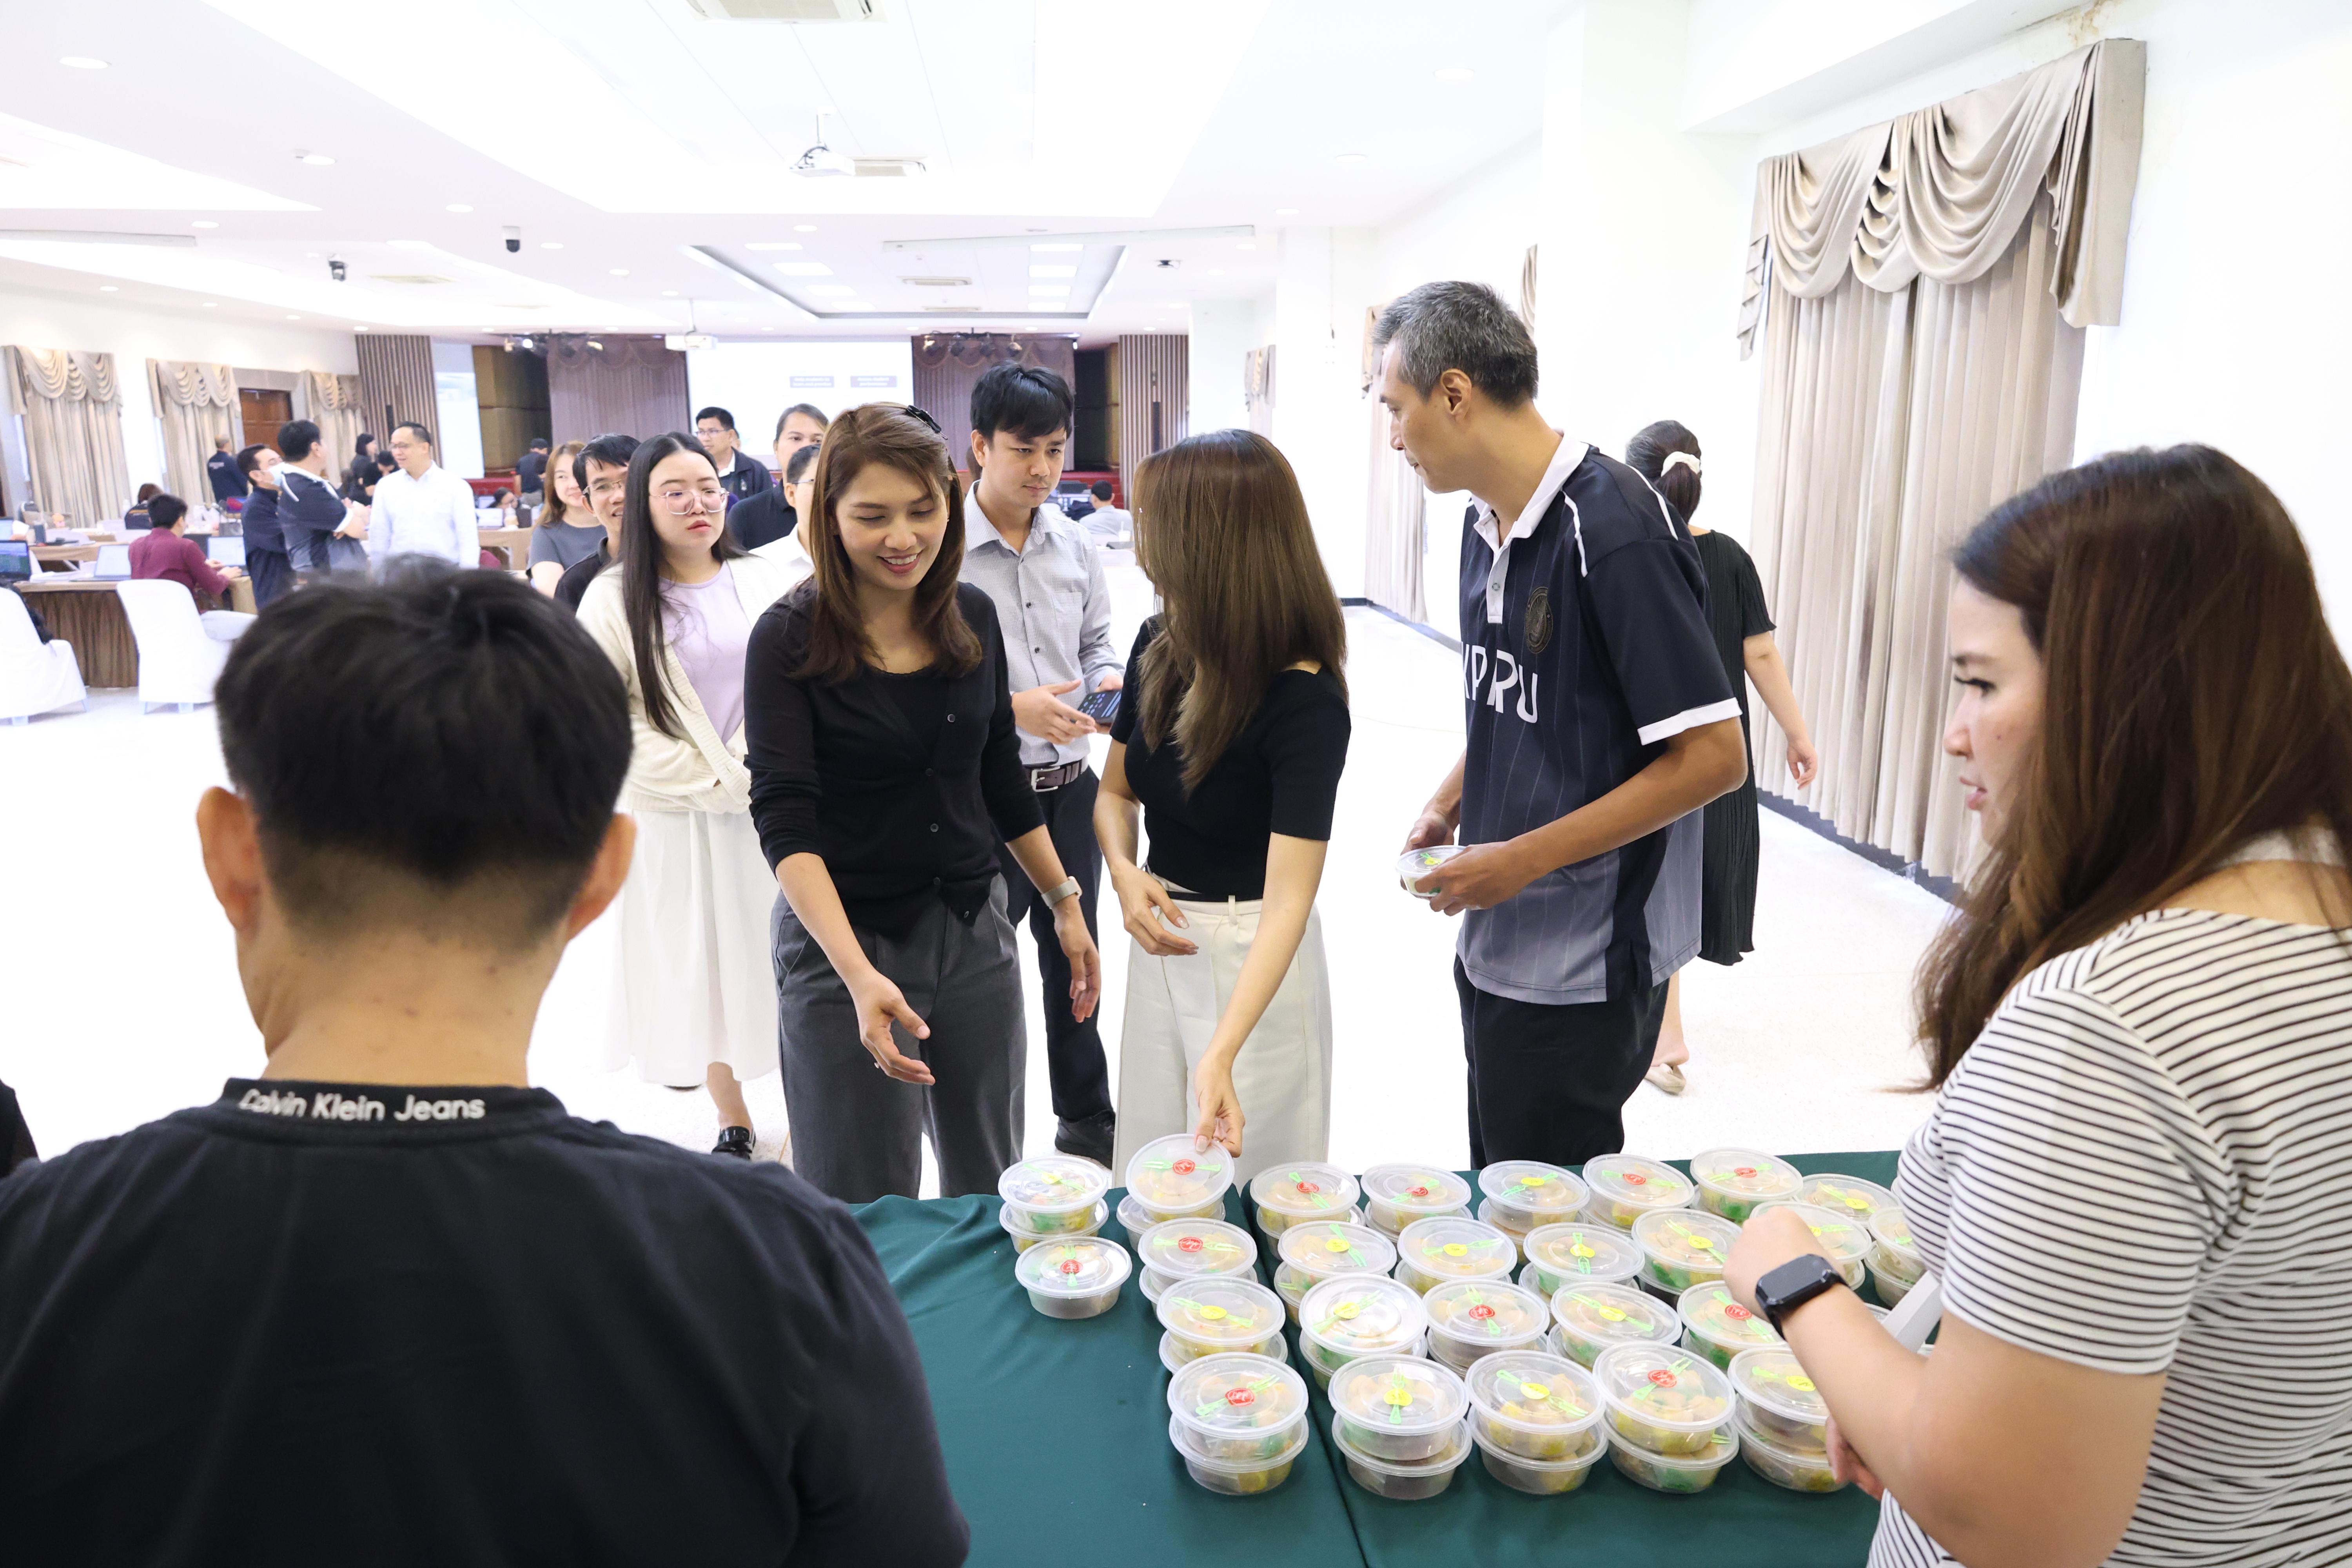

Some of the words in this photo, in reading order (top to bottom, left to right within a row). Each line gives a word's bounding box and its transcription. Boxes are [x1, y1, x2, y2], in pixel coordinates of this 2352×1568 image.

[238, 1089, 307, 1117] Calvin
[312, 1093, 385, 1121] Klein
[394, 1094, 485, 1121] Jeans
